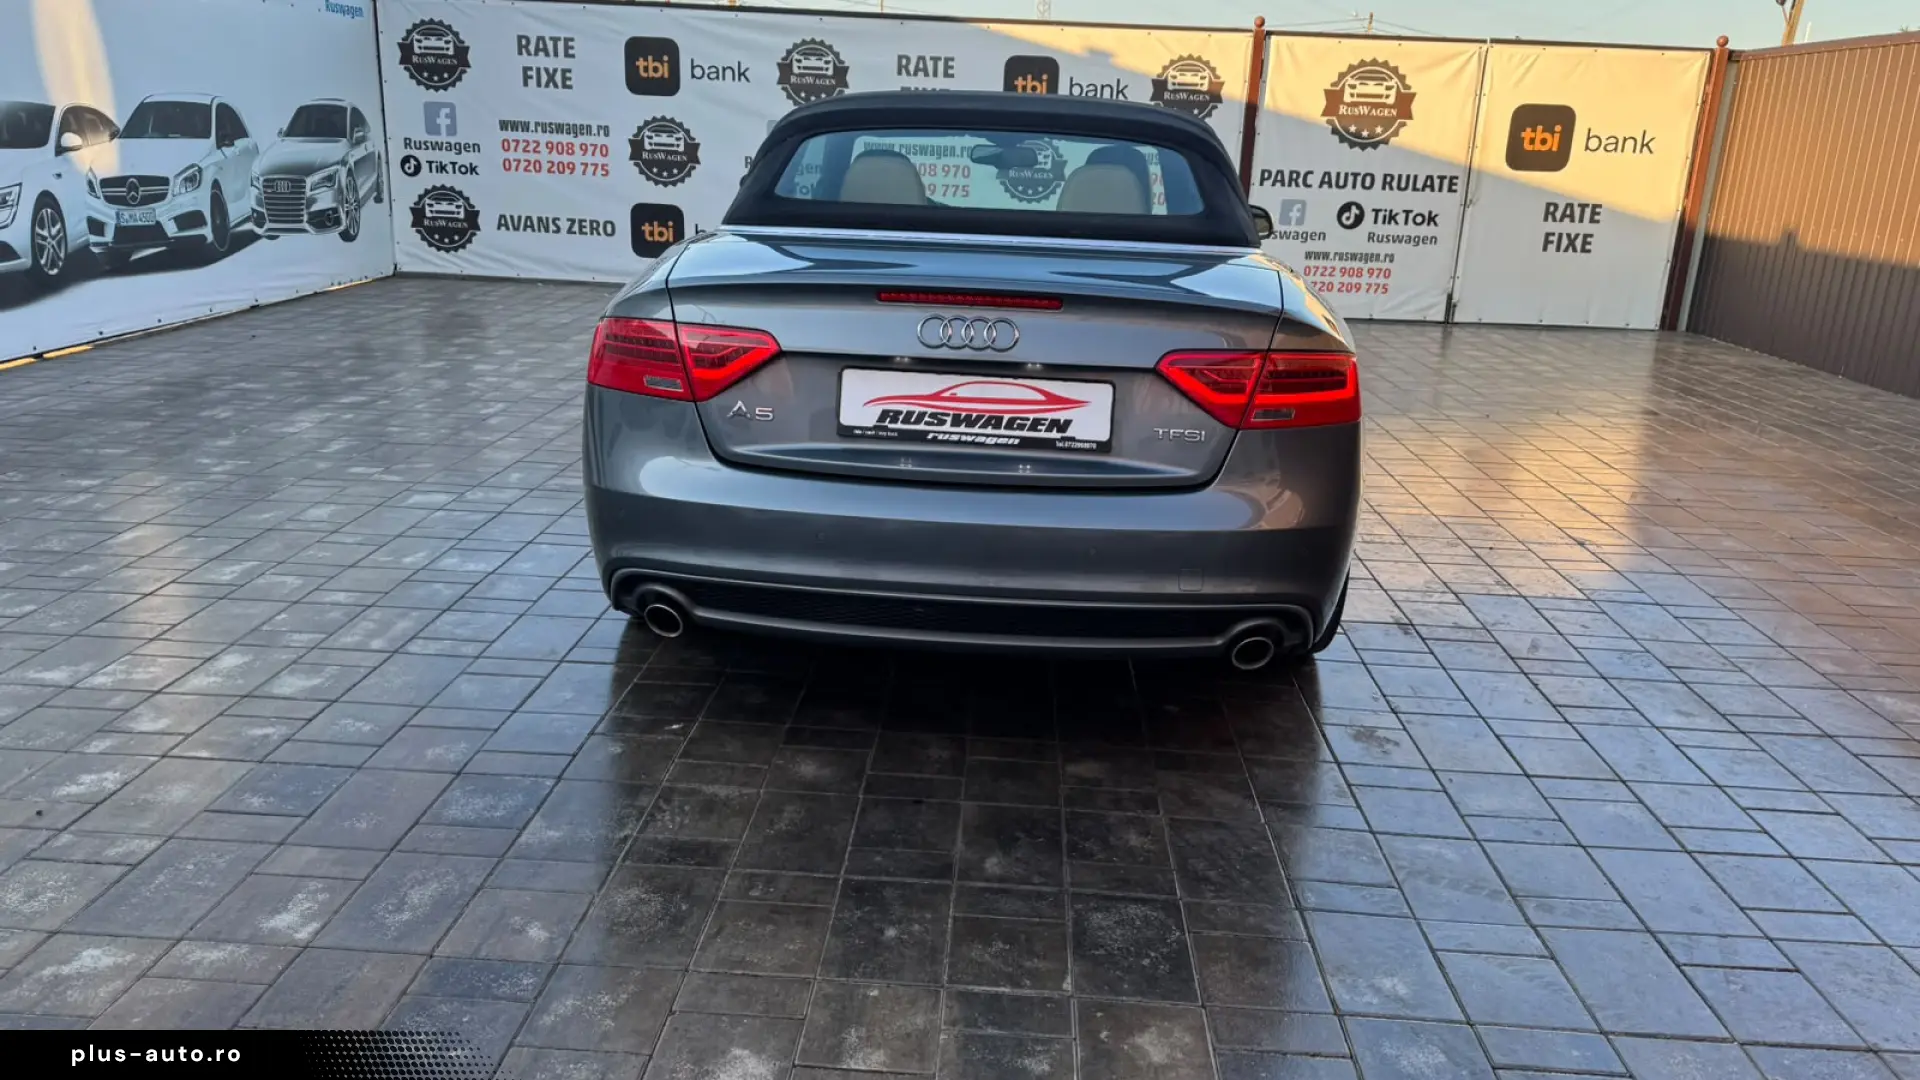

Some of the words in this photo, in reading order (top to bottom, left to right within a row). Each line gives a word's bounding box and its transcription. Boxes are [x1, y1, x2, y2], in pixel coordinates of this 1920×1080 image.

[516, 34, 576, 59] RATE
[636, 56, 669, 79] tbi
[690, 58, 751, 83] bank
[897, 54, 955, 78] RATE
[522, 66, 573, 90] FIXE
[1014, 73, 1048, 95] tbi
[1069, 77, 1130, 100] bank
[499, 119, 610, 138] www.ruswagen.ro
[404, 137, 481, 155] Ruswagen
[501, 138, 541, 154] 0722
[545, 140, 576, 156] 908
[579, 142, 609, 158] 970
[1521, 125, 1562, 152] tbi
[1584, 127, 1656, 155] bank
[426, 160, 480, 176] TikTok
[502, 157, 542, 174] 0720
[546, 160, 576, 175] 209
[580, 162, 610, 177] 775
[941, 164, 971, 179] 970
[941, 183, 970, 198] 775
[1259, 168, 1313, 189] PARC
[1318, 170, 1376, 191] AUTO
[1380, 173, 1459, 194] RULATE
[1371, 207, 1440, 228] TikTok
[1542, 201, 1603, 224] RATE
[496, 213, 561, 234] AVANS
[565, 217, 617, 238] ZERO
[641, 220, 675, 243] tbi
[1270, 228, 1327, 244] swagen
[1367, 231, 1439, 247] Ruswagen
[1541, 231, 1595, 254] FIXE
[1304, 250, 1395, 265] www.ruswagen.ro
[1303, 264, 1336, 278] 0722
[1339, 266, 1364, 279] 908
[1367, 267, 1392, 280] 970
[1337, 281, 1362, 294] 209
[1365, 282, 1389, 295] 775
[876, 408, 1073, 434] RUSWAGEN
[926, 432, 1020, 446] ruswagen
[1153, 427, 1205, 442] TFSI
